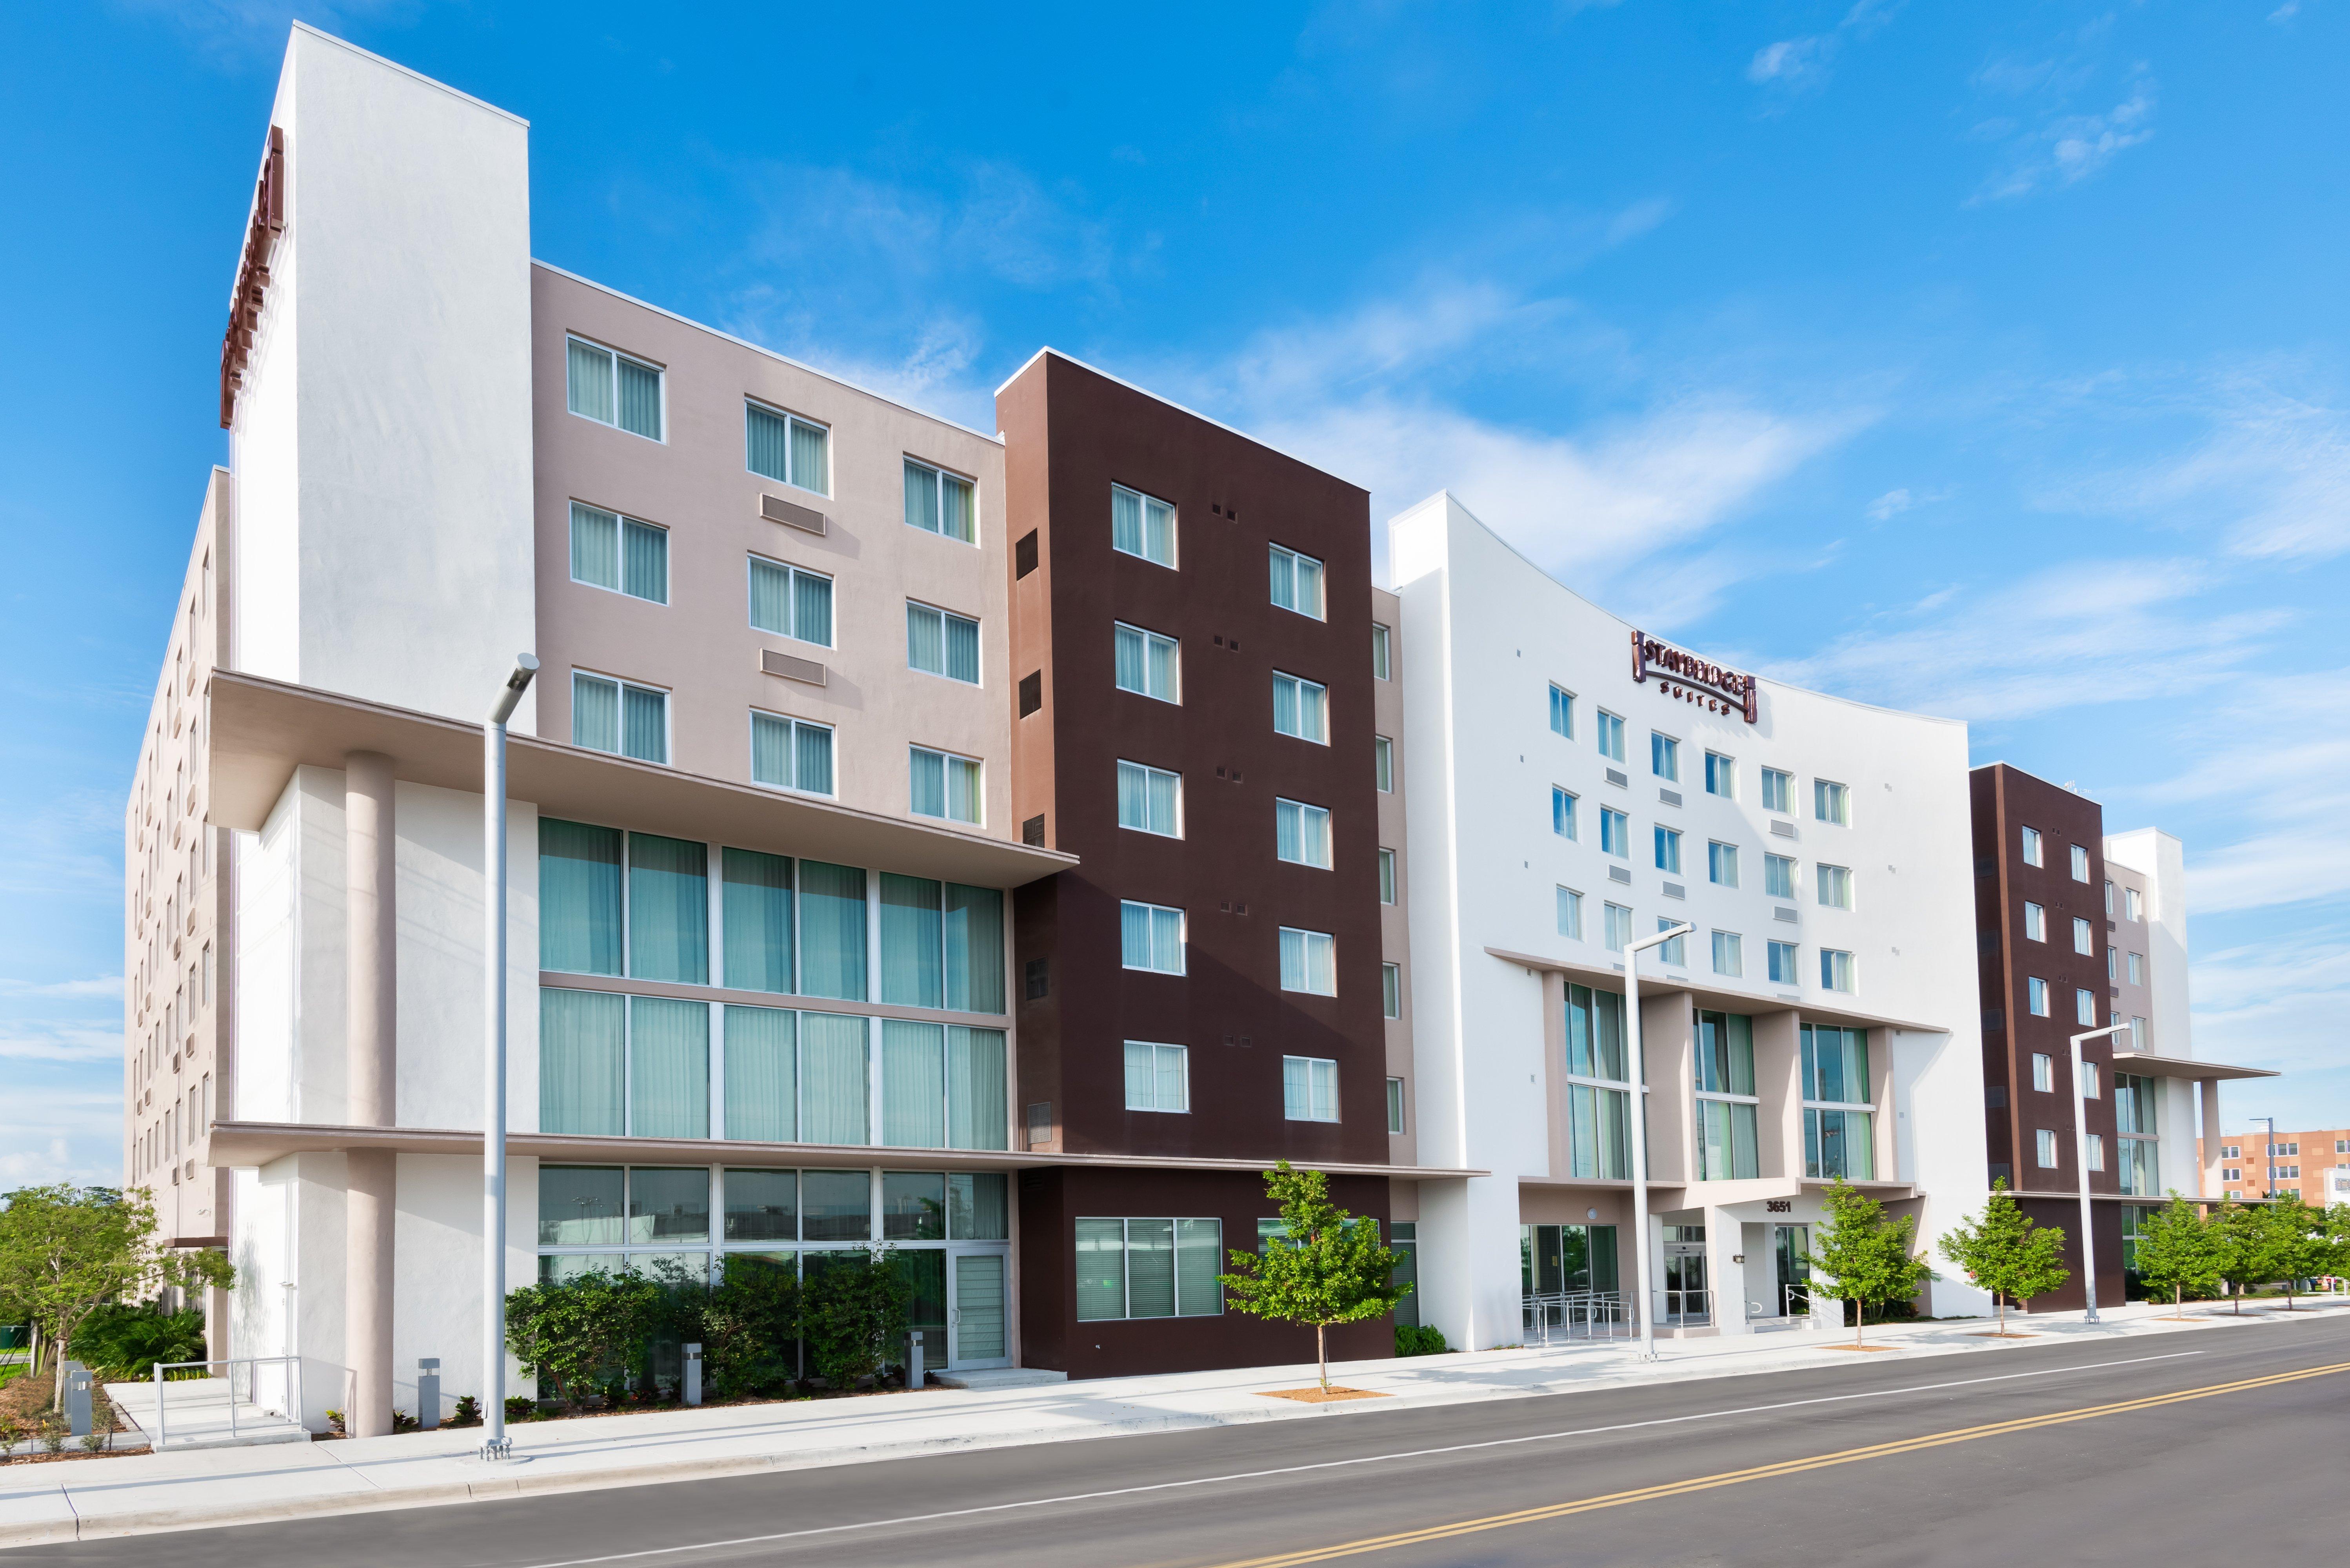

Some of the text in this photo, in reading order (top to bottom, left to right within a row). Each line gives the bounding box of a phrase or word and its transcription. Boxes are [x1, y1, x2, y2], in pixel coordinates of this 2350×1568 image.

[1645, 640, 1744, 696] STAYBRIDGE
[1660, 681, 1730, 716] SUITES
[1767, 1201, 1791, 1212] 3651
